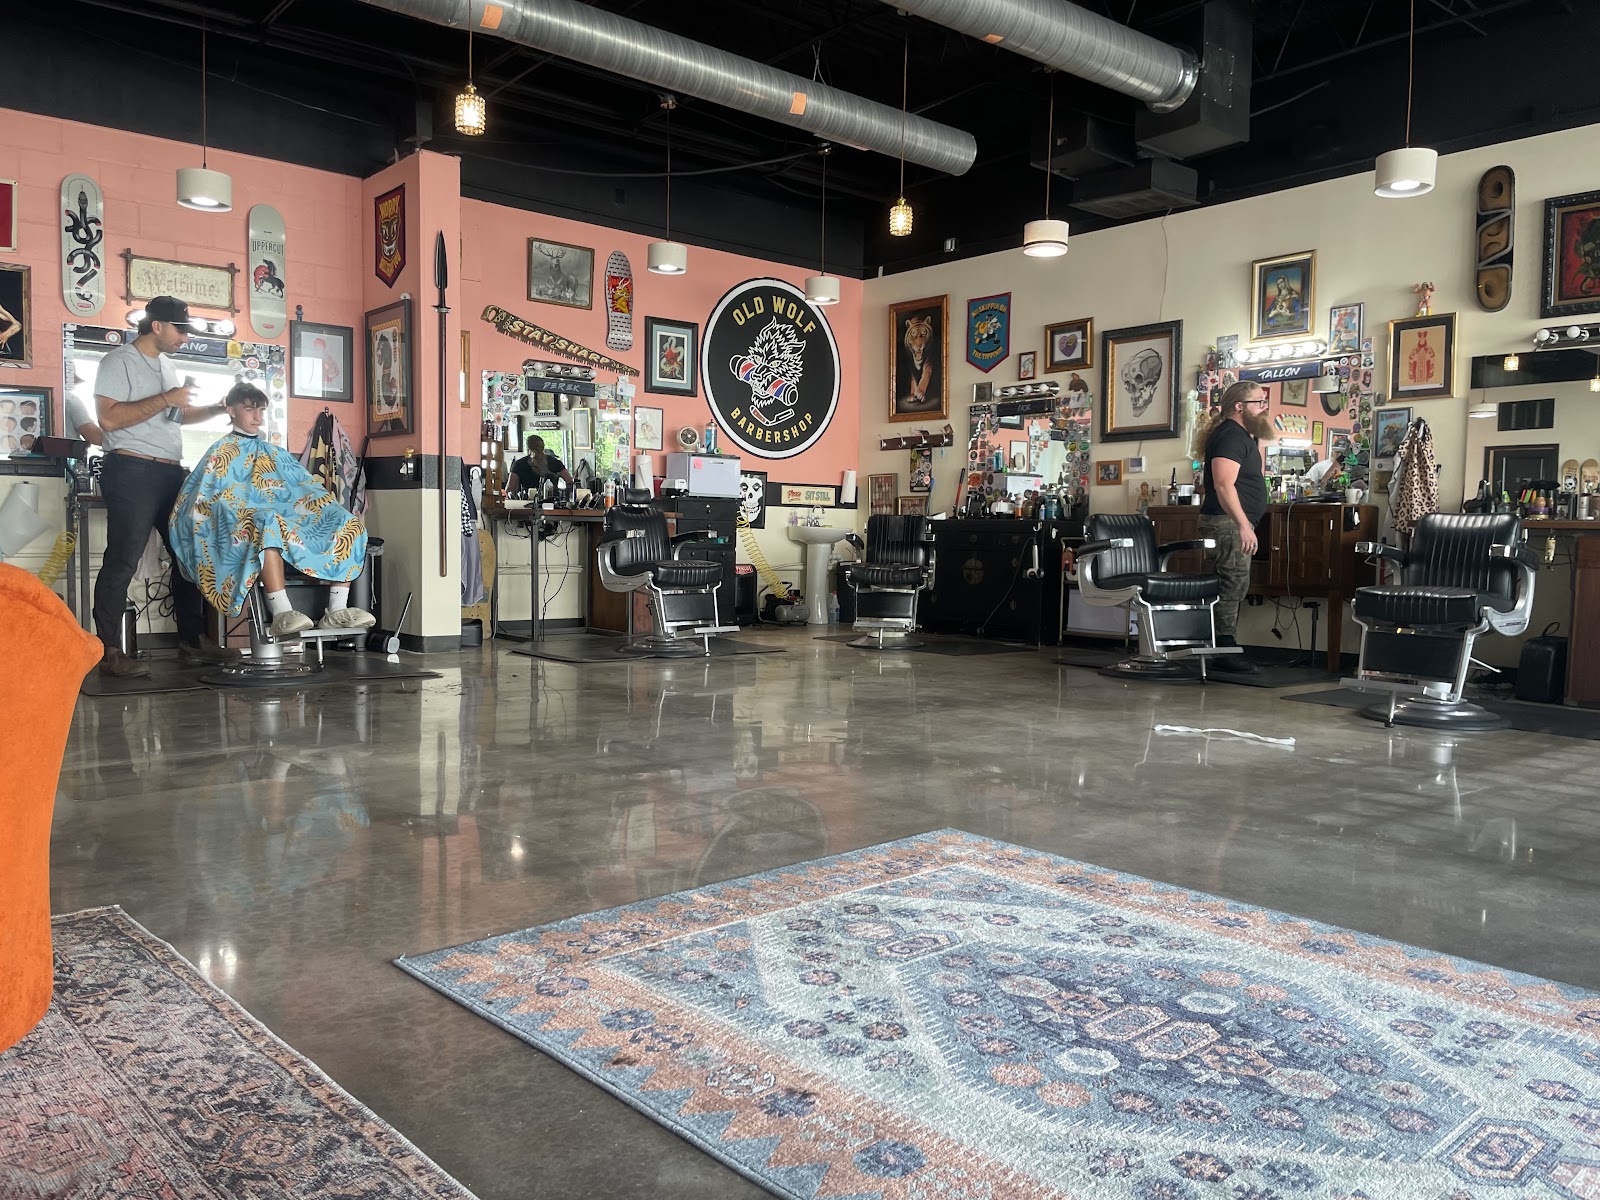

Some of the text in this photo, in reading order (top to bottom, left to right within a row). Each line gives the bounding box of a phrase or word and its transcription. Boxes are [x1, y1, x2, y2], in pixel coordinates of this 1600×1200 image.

[252, 240, 284, 256] UPPERCUT
[143, 266, 216, 298] Welcome
[732, 295, 816, 333] OLD WOLF
[509, 320, 610, 364] STAY SHARP
[1258, 366, 1301, 379] TALLON
[542, 382, 581, 392] DEREK
[730, 406, 813, 443] BARBERSHOP
[804, 490, 815, 501] SIT
[815, 491, 831, 501] STILL
